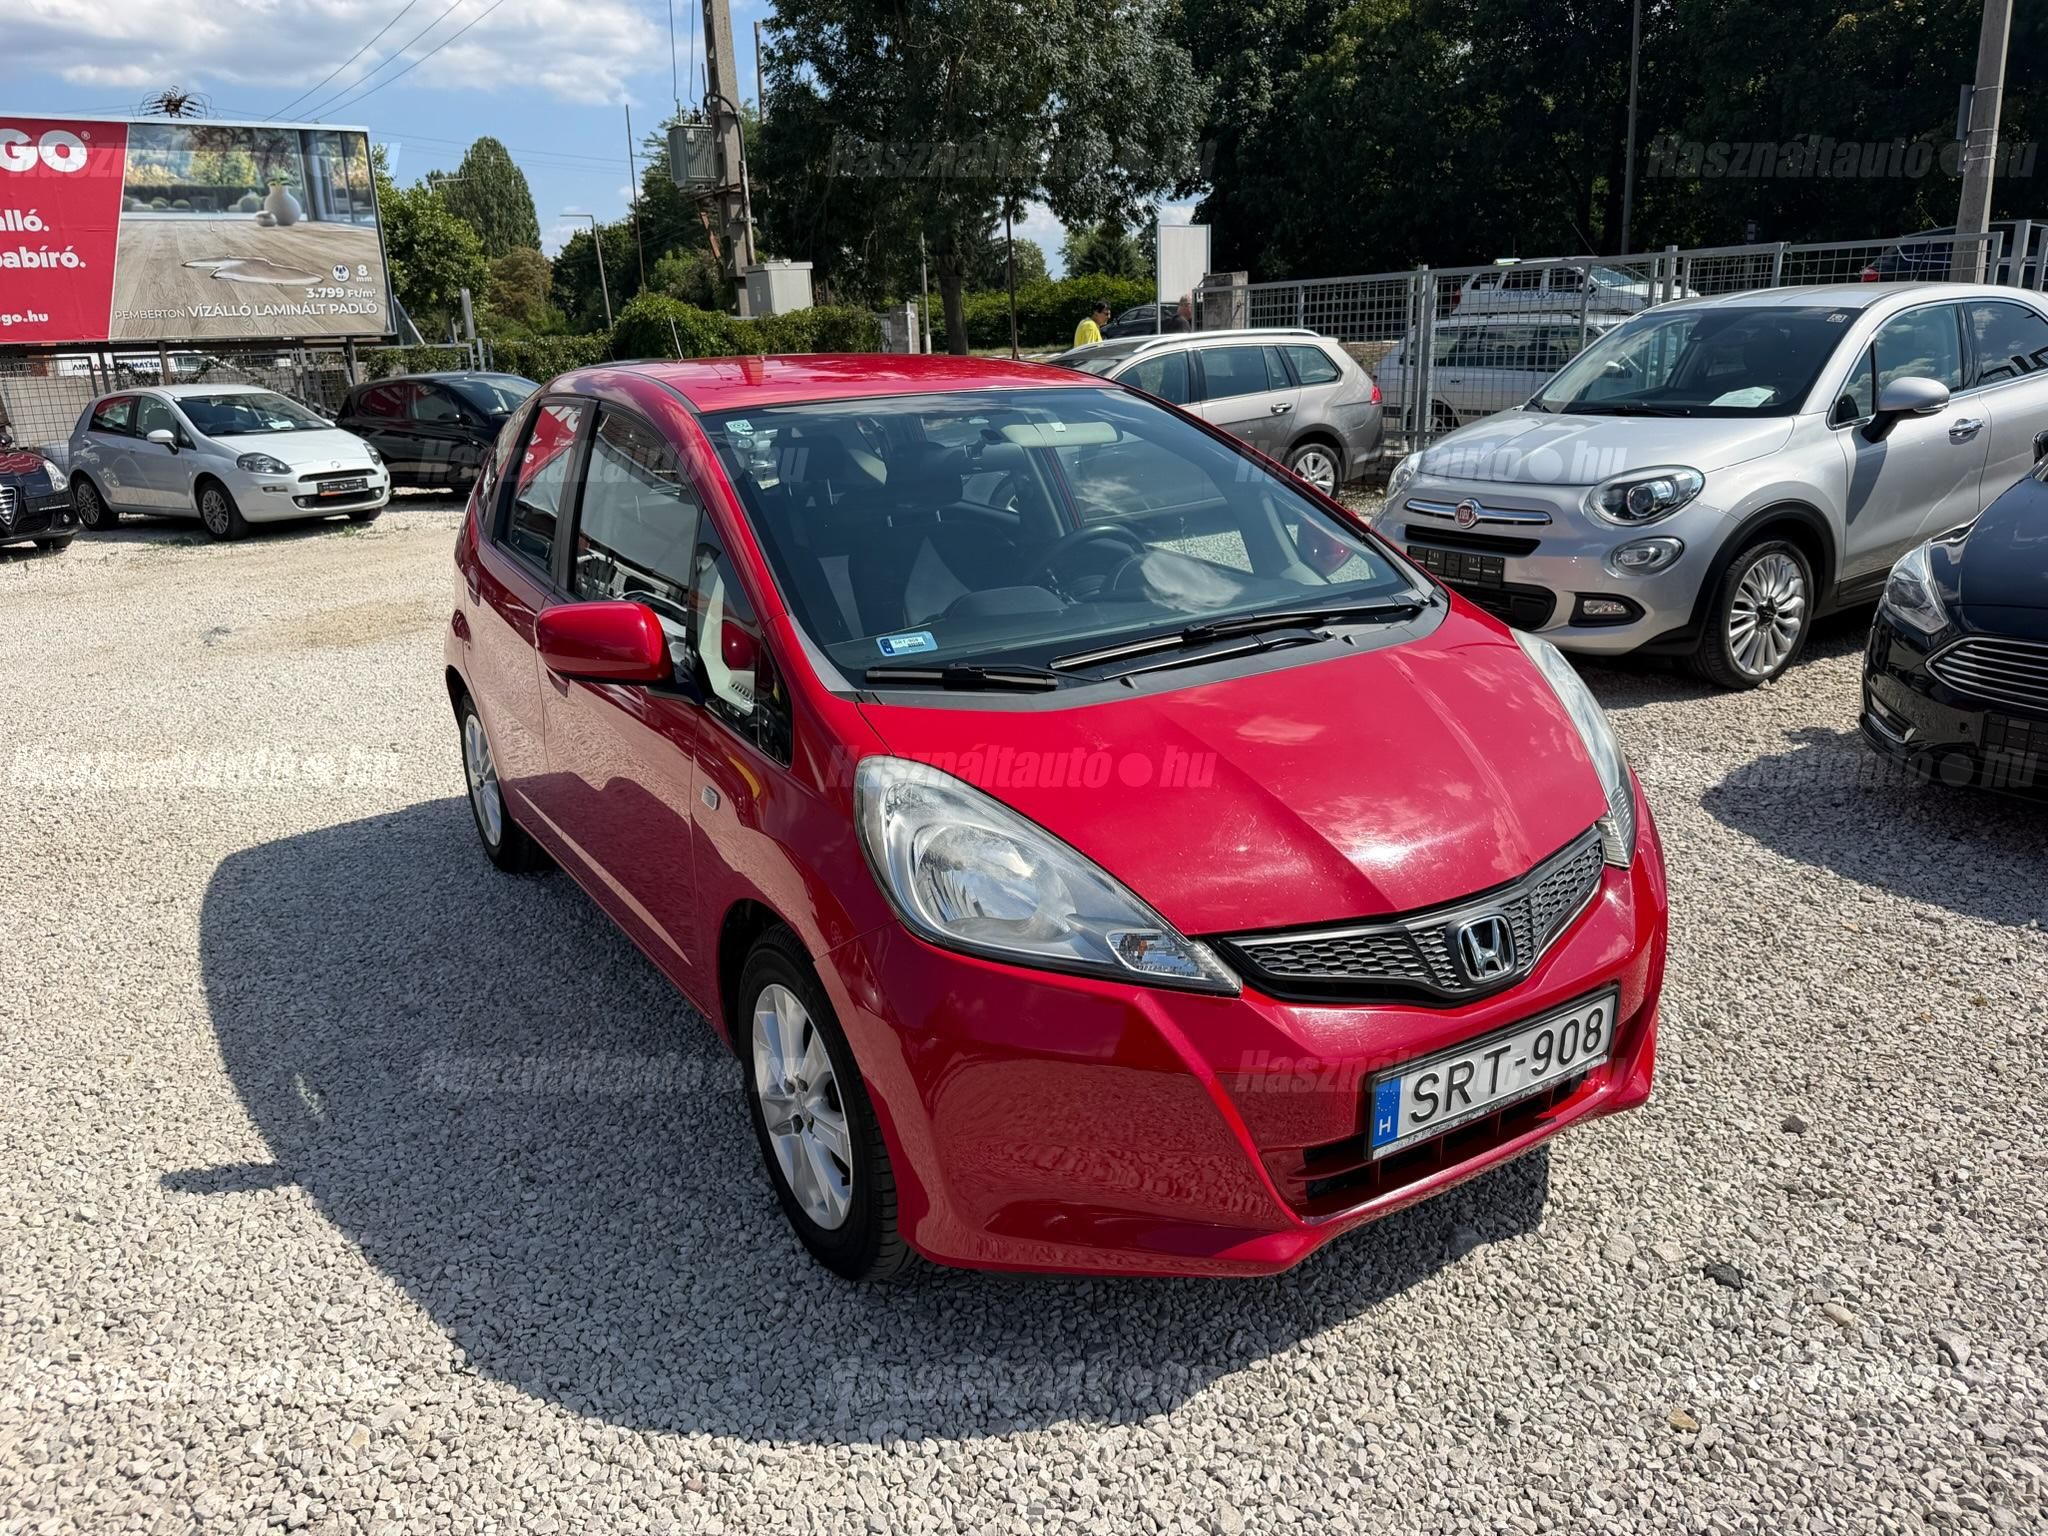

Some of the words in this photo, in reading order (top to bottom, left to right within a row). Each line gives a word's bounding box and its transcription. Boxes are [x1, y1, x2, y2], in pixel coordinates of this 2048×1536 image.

[0, 245, 87, 268] abíró.
[357, 264, 368, 276] 8
[306, 287, 345, 298] 3.799
[0, 310, 48, 326] go.hu
[114, 309, 186, 320] PEMBERTON
[188, 303, 251, 318] VÍZÁLLÓ
[255, 301, 327, 317] LAMINÁLT
[329, 300, 378, 315] PADLÓ
[1410, 1007, 1604, 1123] SRT-908
[1378, 1115, 1391, 1136] H
